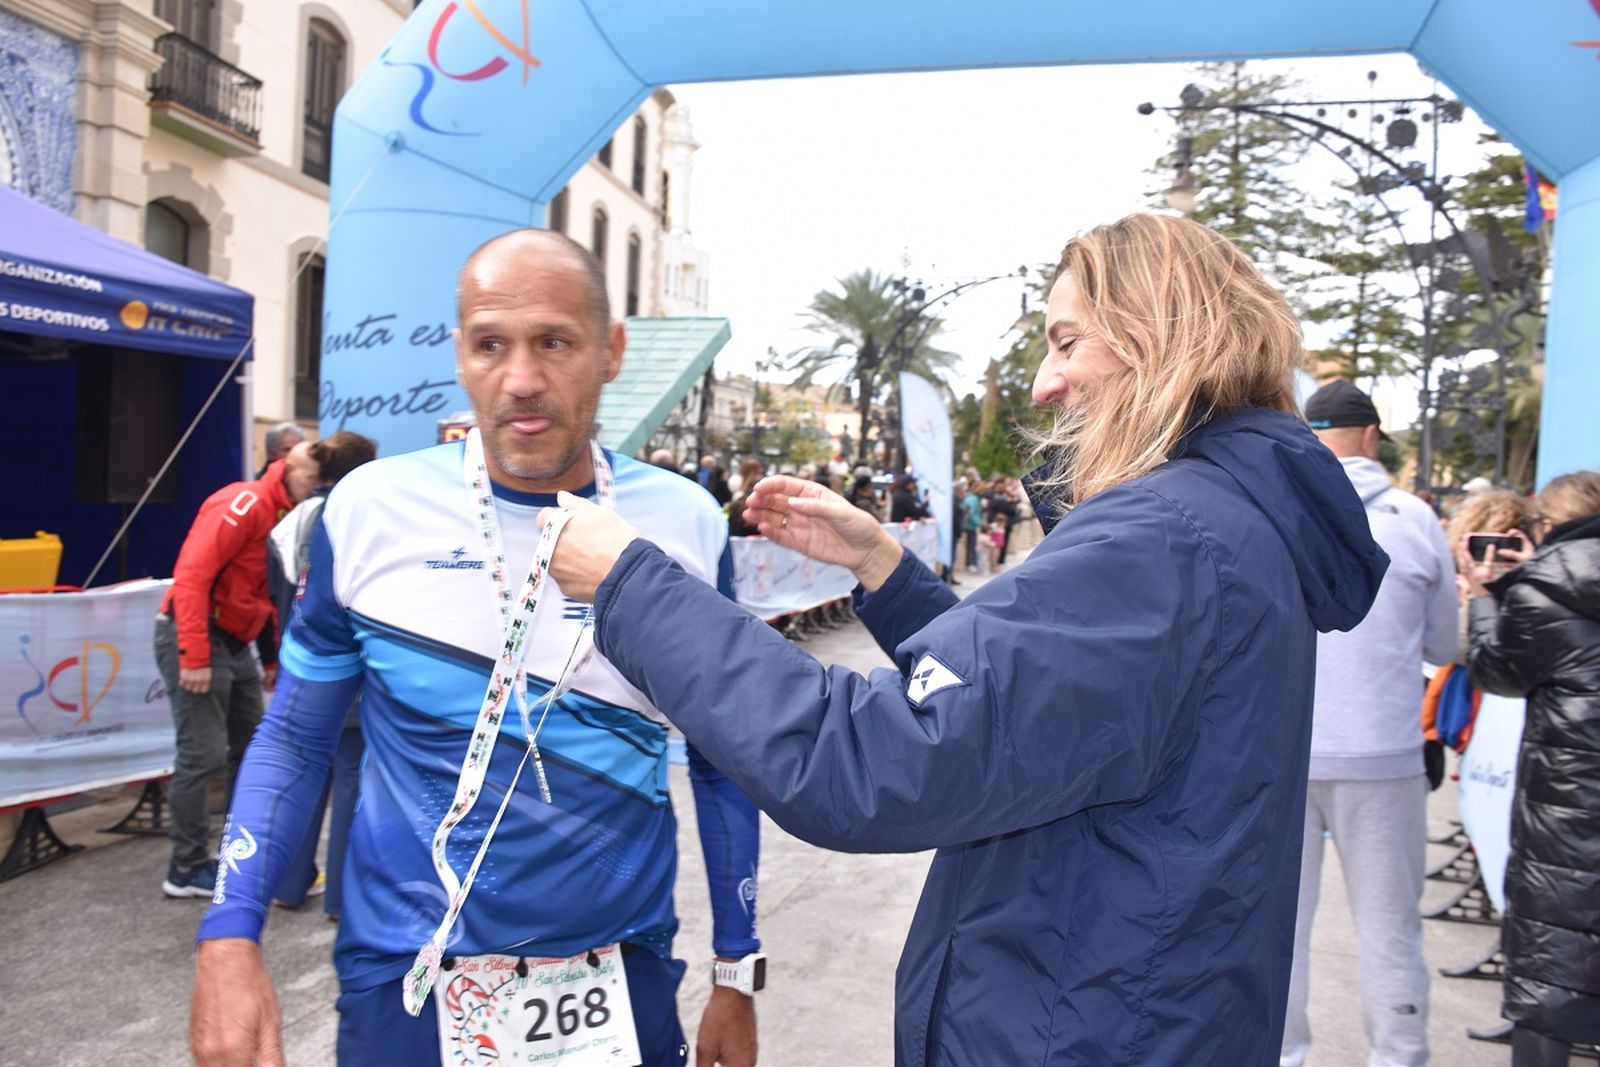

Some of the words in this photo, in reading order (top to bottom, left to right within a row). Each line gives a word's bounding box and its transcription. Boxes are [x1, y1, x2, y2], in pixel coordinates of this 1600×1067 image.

[10, 303, 110, 331] DEPORTIVOS
[409, 323, 453, 347] es
[319, 379, 457, 431] Deporte
[523, 987, 610, 1043] 268
[528, 1051, 557, 1063] Carlos
